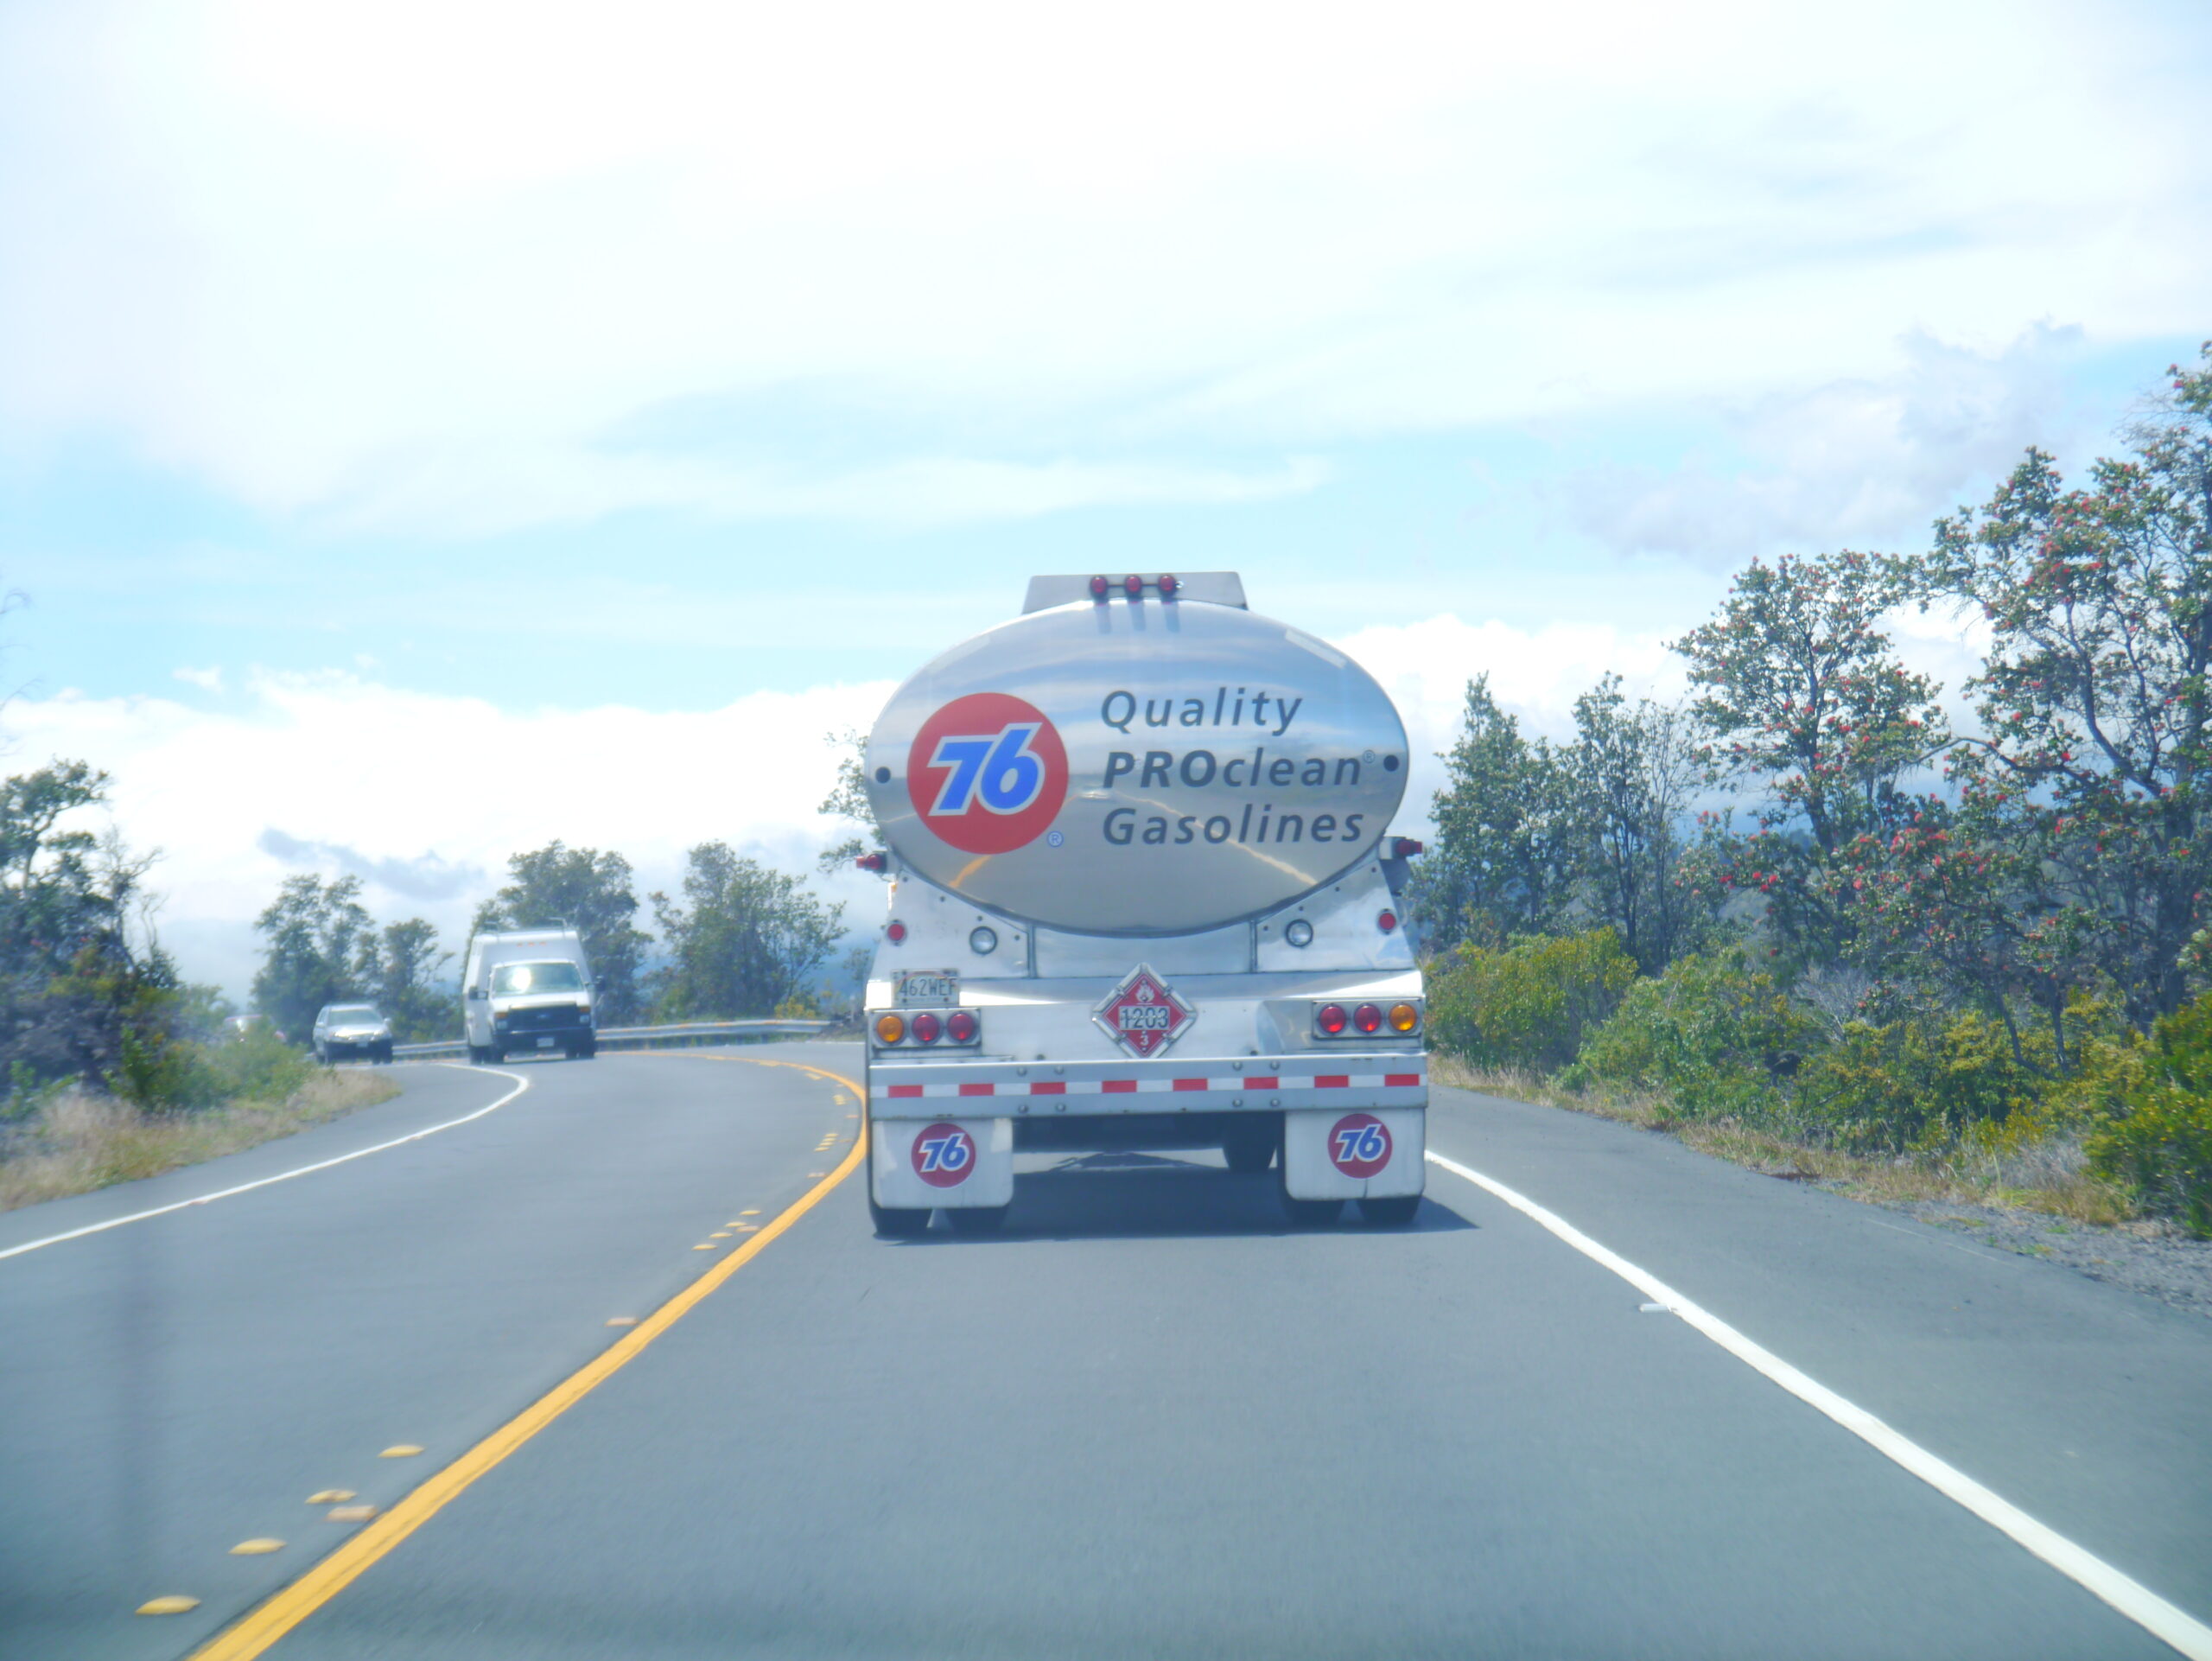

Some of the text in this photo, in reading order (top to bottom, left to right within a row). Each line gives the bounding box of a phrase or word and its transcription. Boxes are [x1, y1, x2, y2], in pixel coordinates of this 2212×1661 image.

[1101, 687, 1302, 736] Quality
[926, 722, 1046, 816] 76
[1103, 804, 1363, 845] Gasolines
[1122, 1007, 1168, 1028] 1203
[1140, 1034, 1149, 1047] 3
[918, 1132, 969, 1172] 76
[1335, 1123, 1386, 1162] 76
